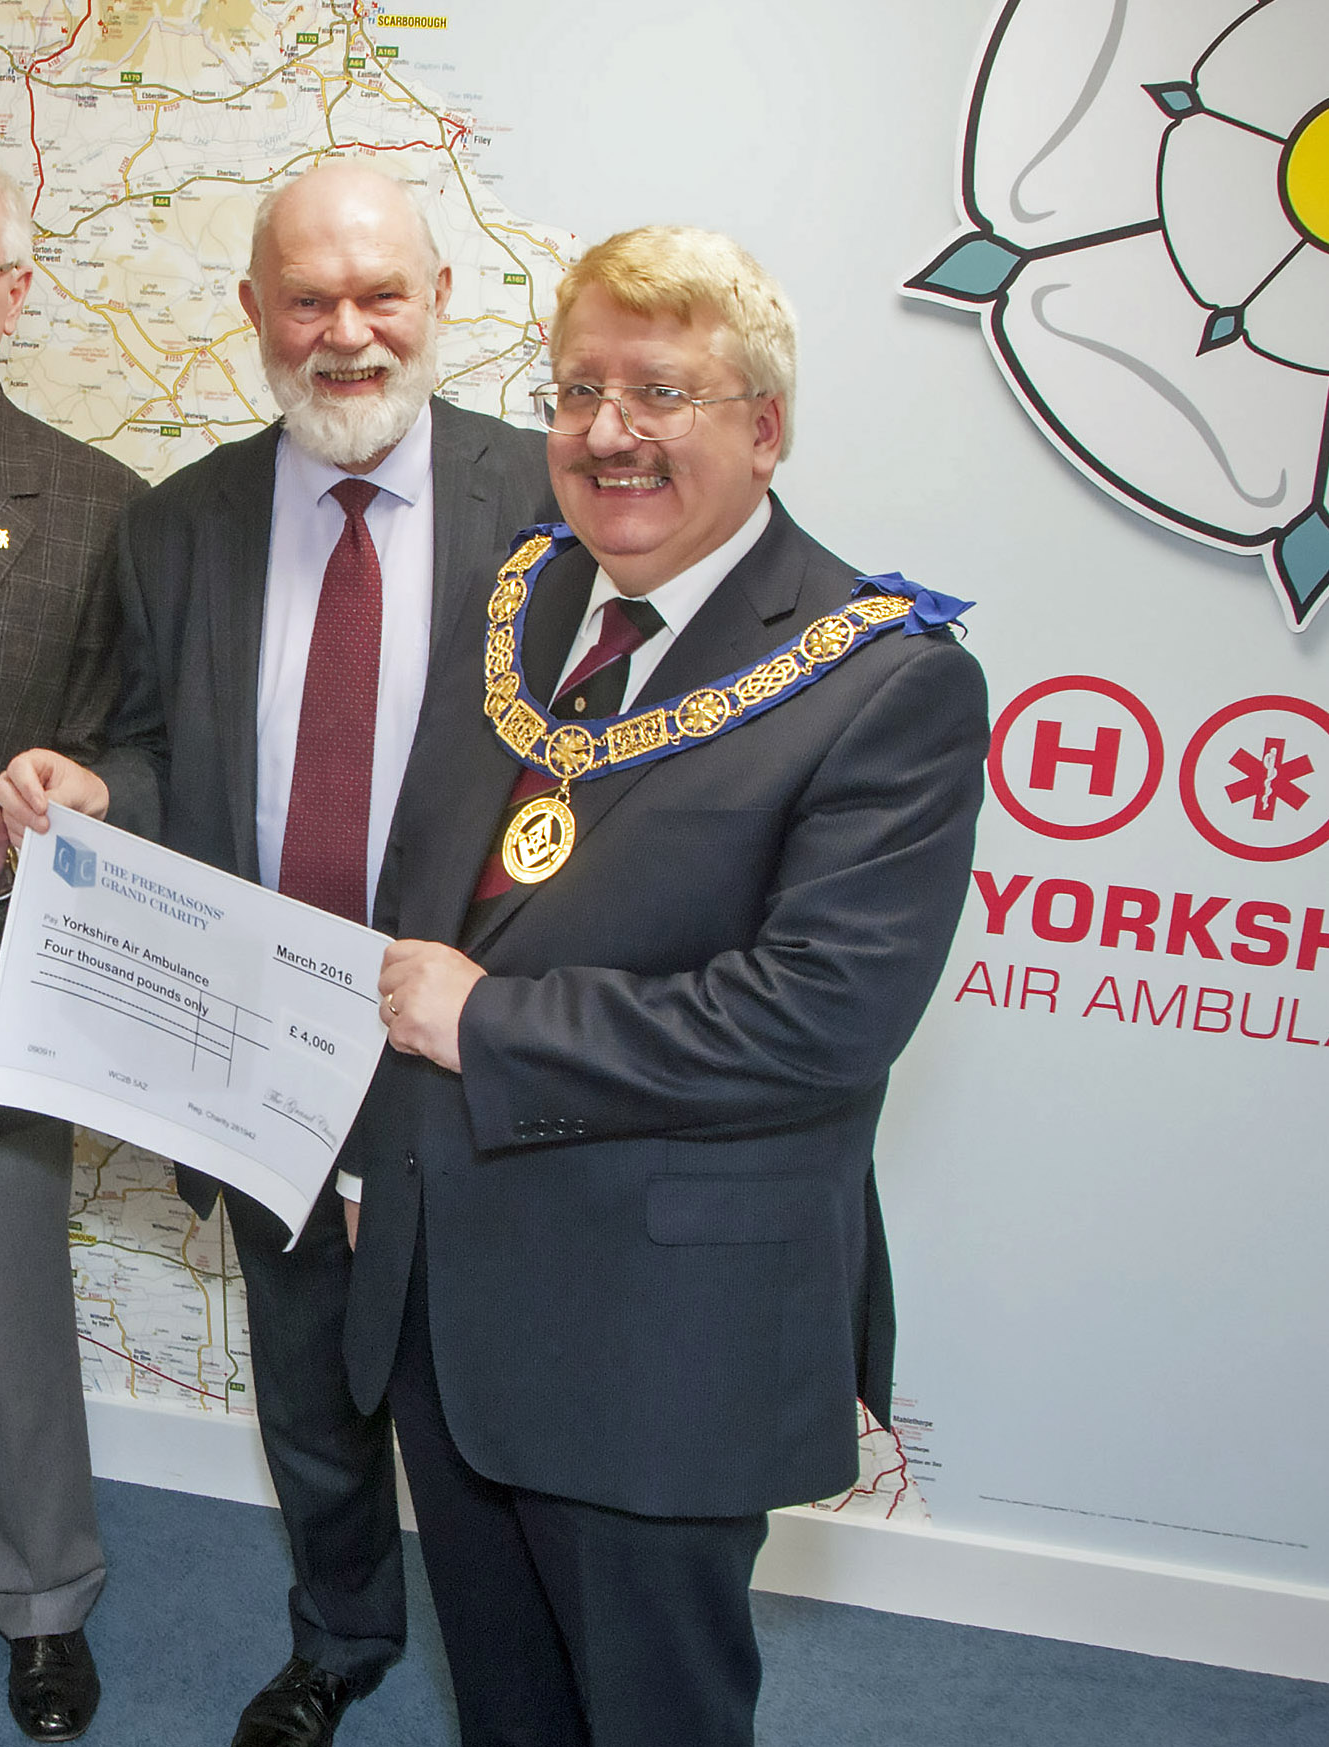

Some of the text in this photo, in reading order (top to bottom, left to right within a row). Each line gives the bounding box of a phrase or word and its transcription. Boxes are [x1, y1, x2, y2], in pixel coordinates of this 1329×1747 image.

[378, 16, 447, 28] SCARBOROUGH
[474, 136, 491, 145] Filey
[34, 254, 60, 262] Derwent
[103, 860, 128, 879] THE
[101, 877, 209, 930] GRAND CHARITY
[62, 915, 119, 947] Yorkshire
[123, 939, 140, 954] Air
[142, 947, 209, 987] Ambulance
[276, 944, 352, 985] March 2016
[44, 939, 209, 1016] Four thousand pounds only
[955, 961, 1329, 1047] AIR AMBUL
[289, 1026, 335, 1055] £ 4,000
[893, 1416, 932, 1427] Mablethorpe
